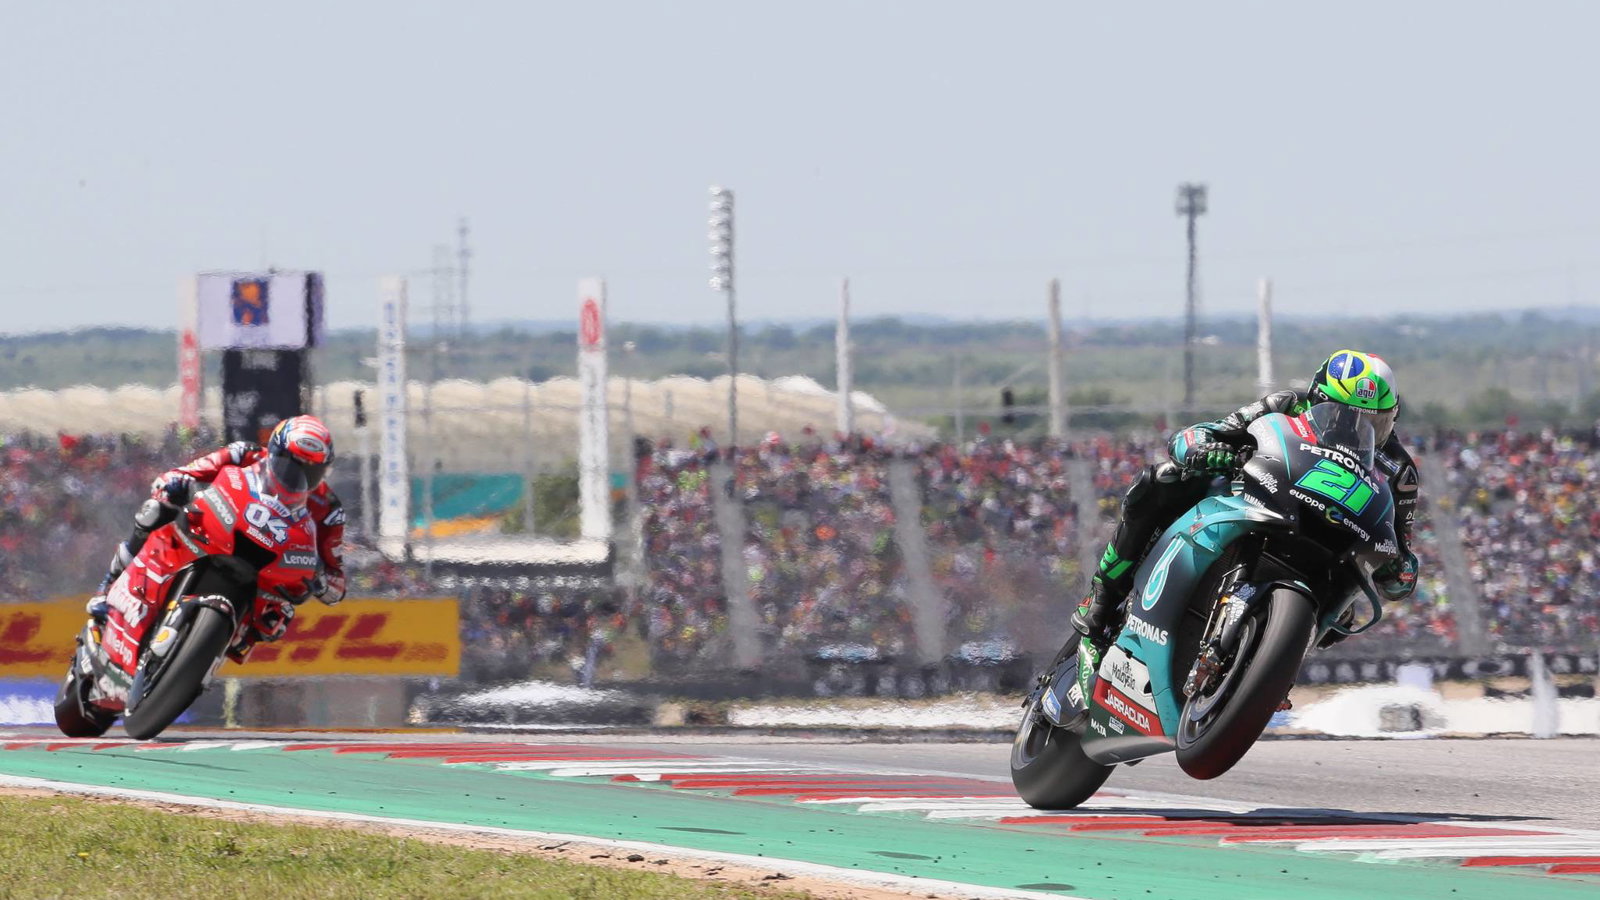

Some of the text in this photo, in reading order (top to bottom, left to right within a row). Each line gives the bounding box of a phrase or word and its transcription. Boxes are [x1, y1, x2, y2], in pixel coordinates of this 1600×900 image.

[1300, 443, 1380, 494] PETRONAS
[1336, 444, 1360, 462] YAMAHA
[1244, 492, 1266, 510] YAMAHA
[1294, 458, 1376, 516] 21
[206, 489, 234, 525] Lenovo
[244, 502, 290, 544] 04
[1290, 488, 1370, 542] europe energy
[249, 612, 402, 662] HL
[1126, 613, 1168, 646] PETRONAS
[1112, 662, 1136, 690] Malaysia
